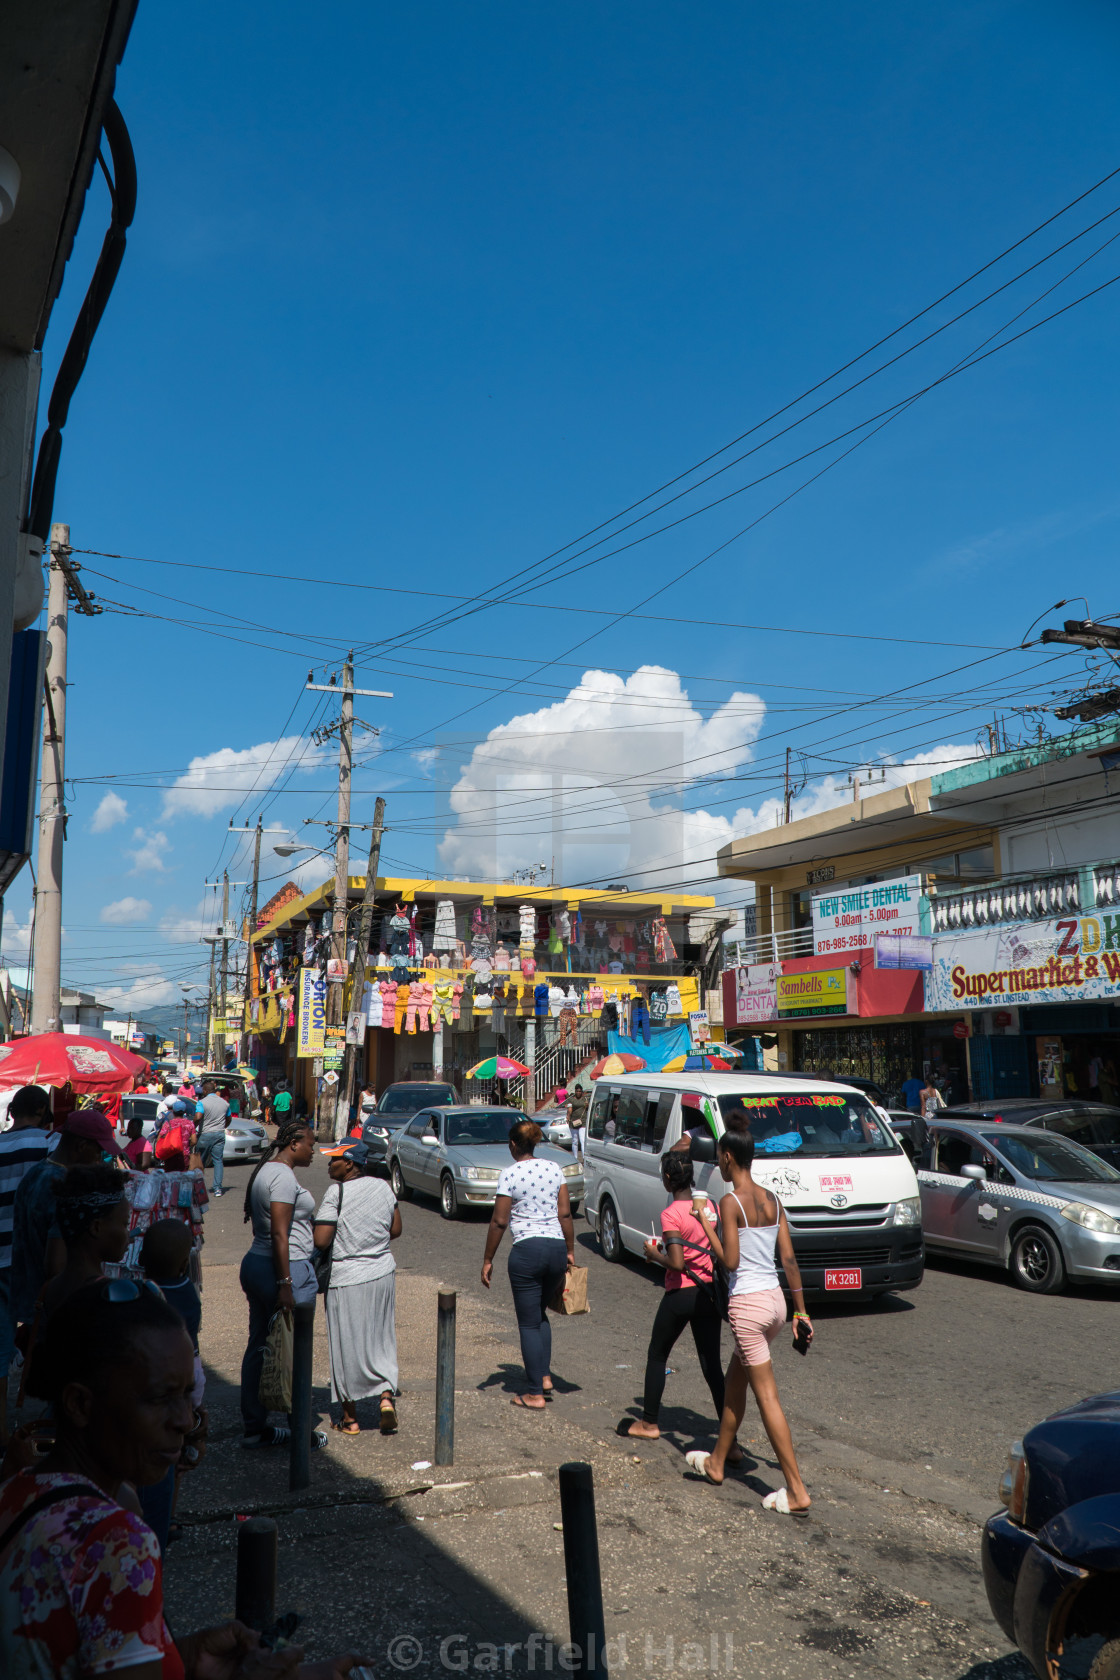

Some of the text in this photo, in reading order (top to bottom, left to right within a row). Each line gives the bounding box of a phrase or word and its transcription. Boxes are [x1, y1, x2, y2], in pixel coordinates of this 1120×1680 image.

[820, 883, 912, 918] NEW SMILE DENTAL
[834, 914, 863, 928] 9.00am
[869, 907, 899, 922] 5.00pm
[817, 934, 868, 952] 876-985-2568
[780, 976, 822, 996] Sambells
[951, 953, 1085, 999] Supermarket
[1084, 955, 1100, 978] &
[302, 970, 312, 1046] INSURANCE BROKERS
[312, 981, 326, 1030] ORION
[741, 1096, 780, 1110] BEAT
[810, 1095, 847, 1107] BAD
[827, 1273, 859, 1286] PK 3281
